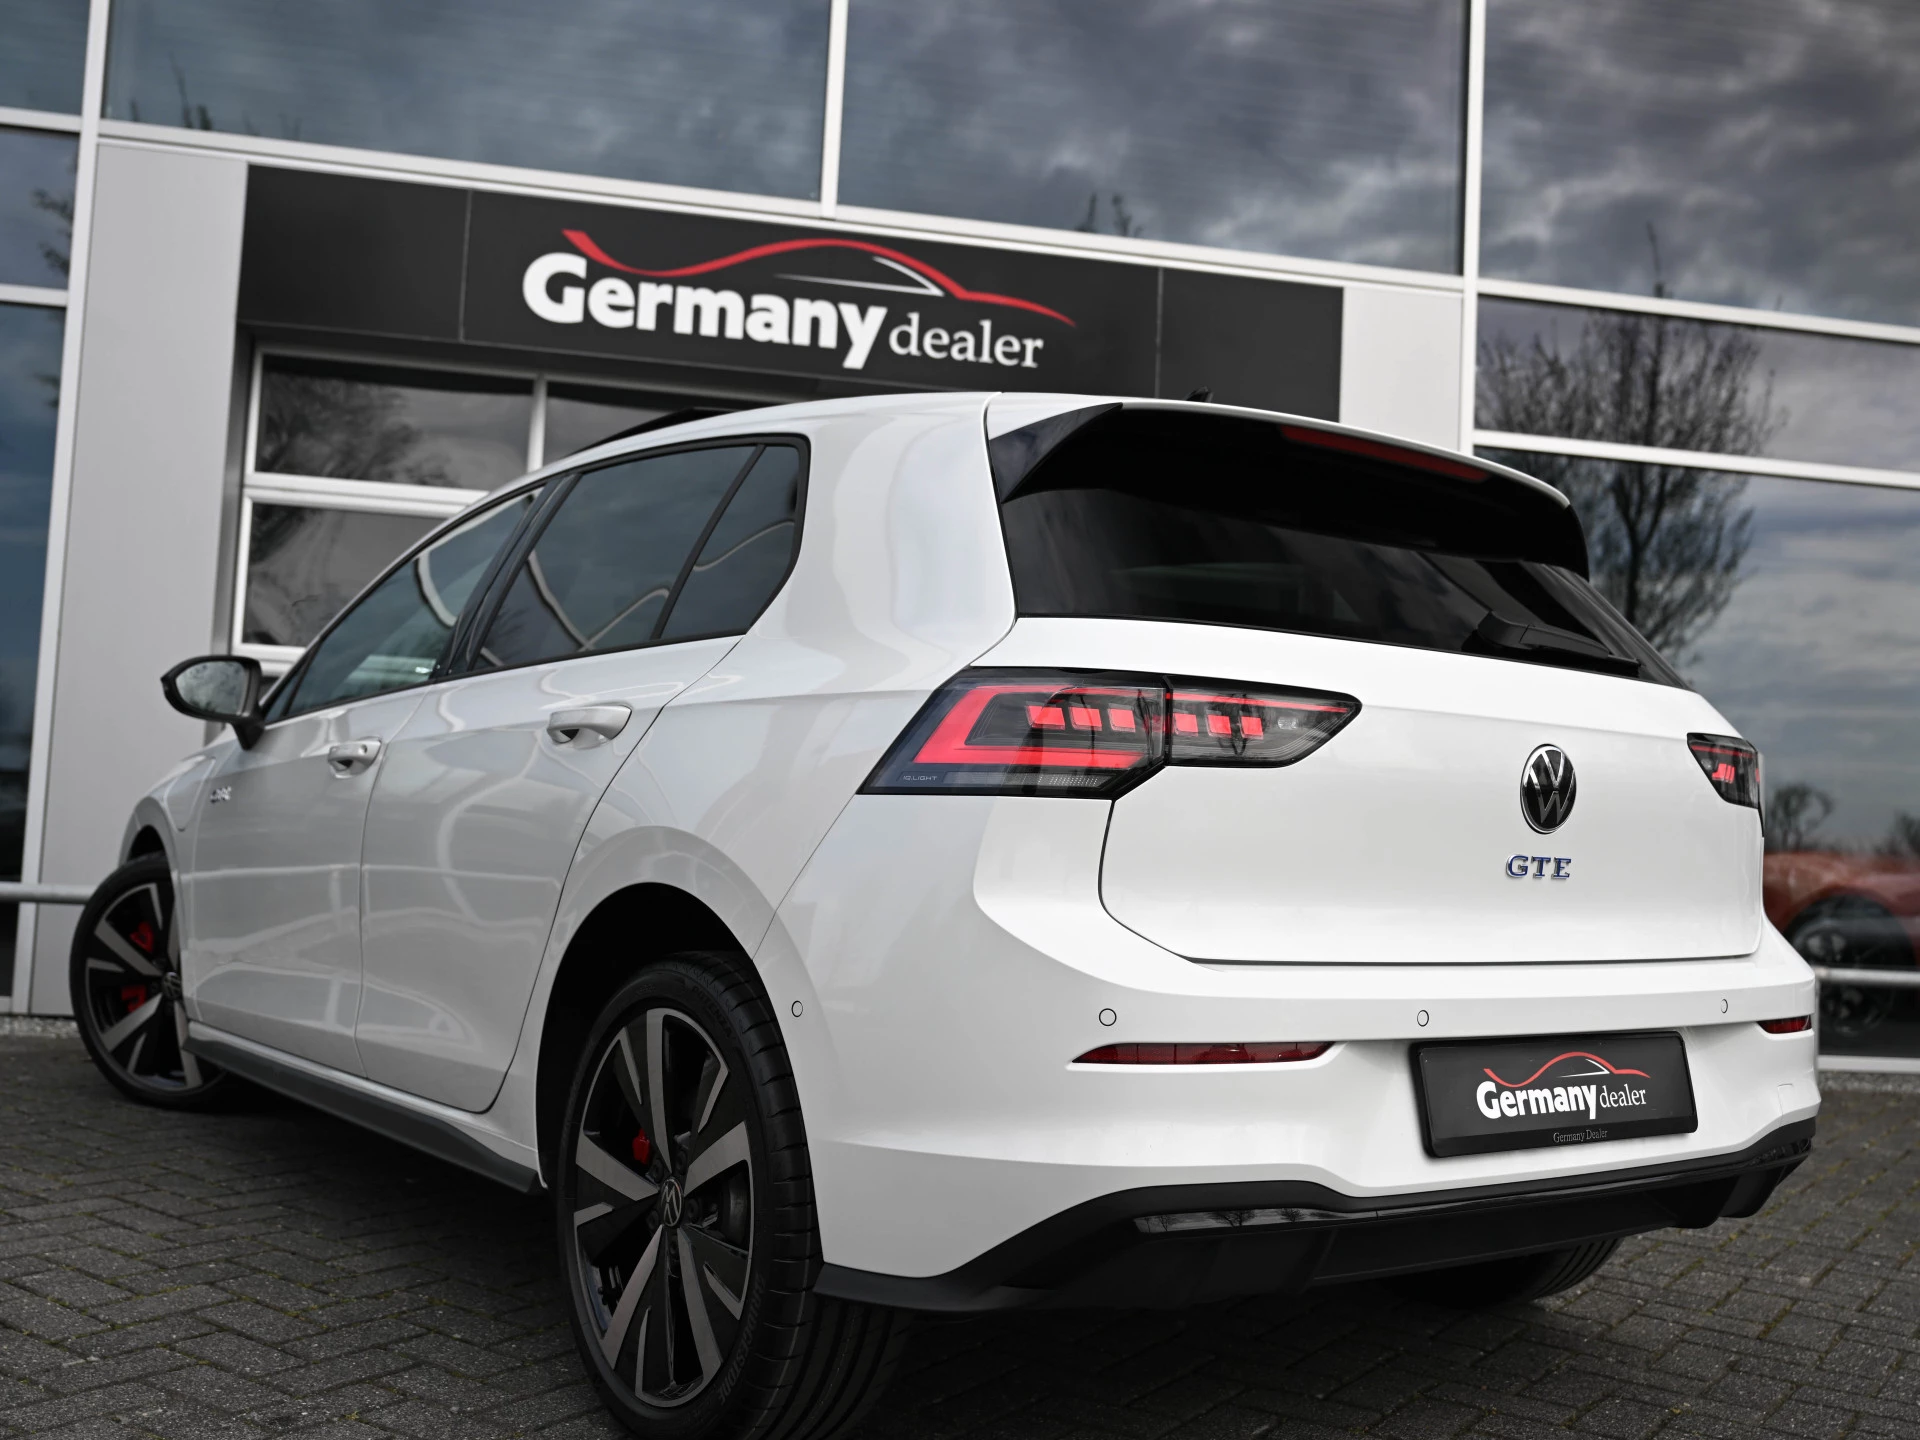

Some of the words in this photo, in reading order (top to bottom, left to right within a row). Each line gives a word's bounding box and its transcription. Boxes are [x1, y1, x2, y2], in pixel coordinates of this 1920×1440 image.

[522, 252, 887, 369] Germany
[888, 312, 1044, 367] dealer
[1506, 854, 1572, 879] GTE
[1476, 1081, 1596, 1120] Germany
[1600, 1084, 1647, 1108] dealer
[1553, 1132, 1585, 1142] Germany
[1586, 1129, 1608, 1139] Dealer
[717, 1272, 766, 1406] BRIDGESTONE
